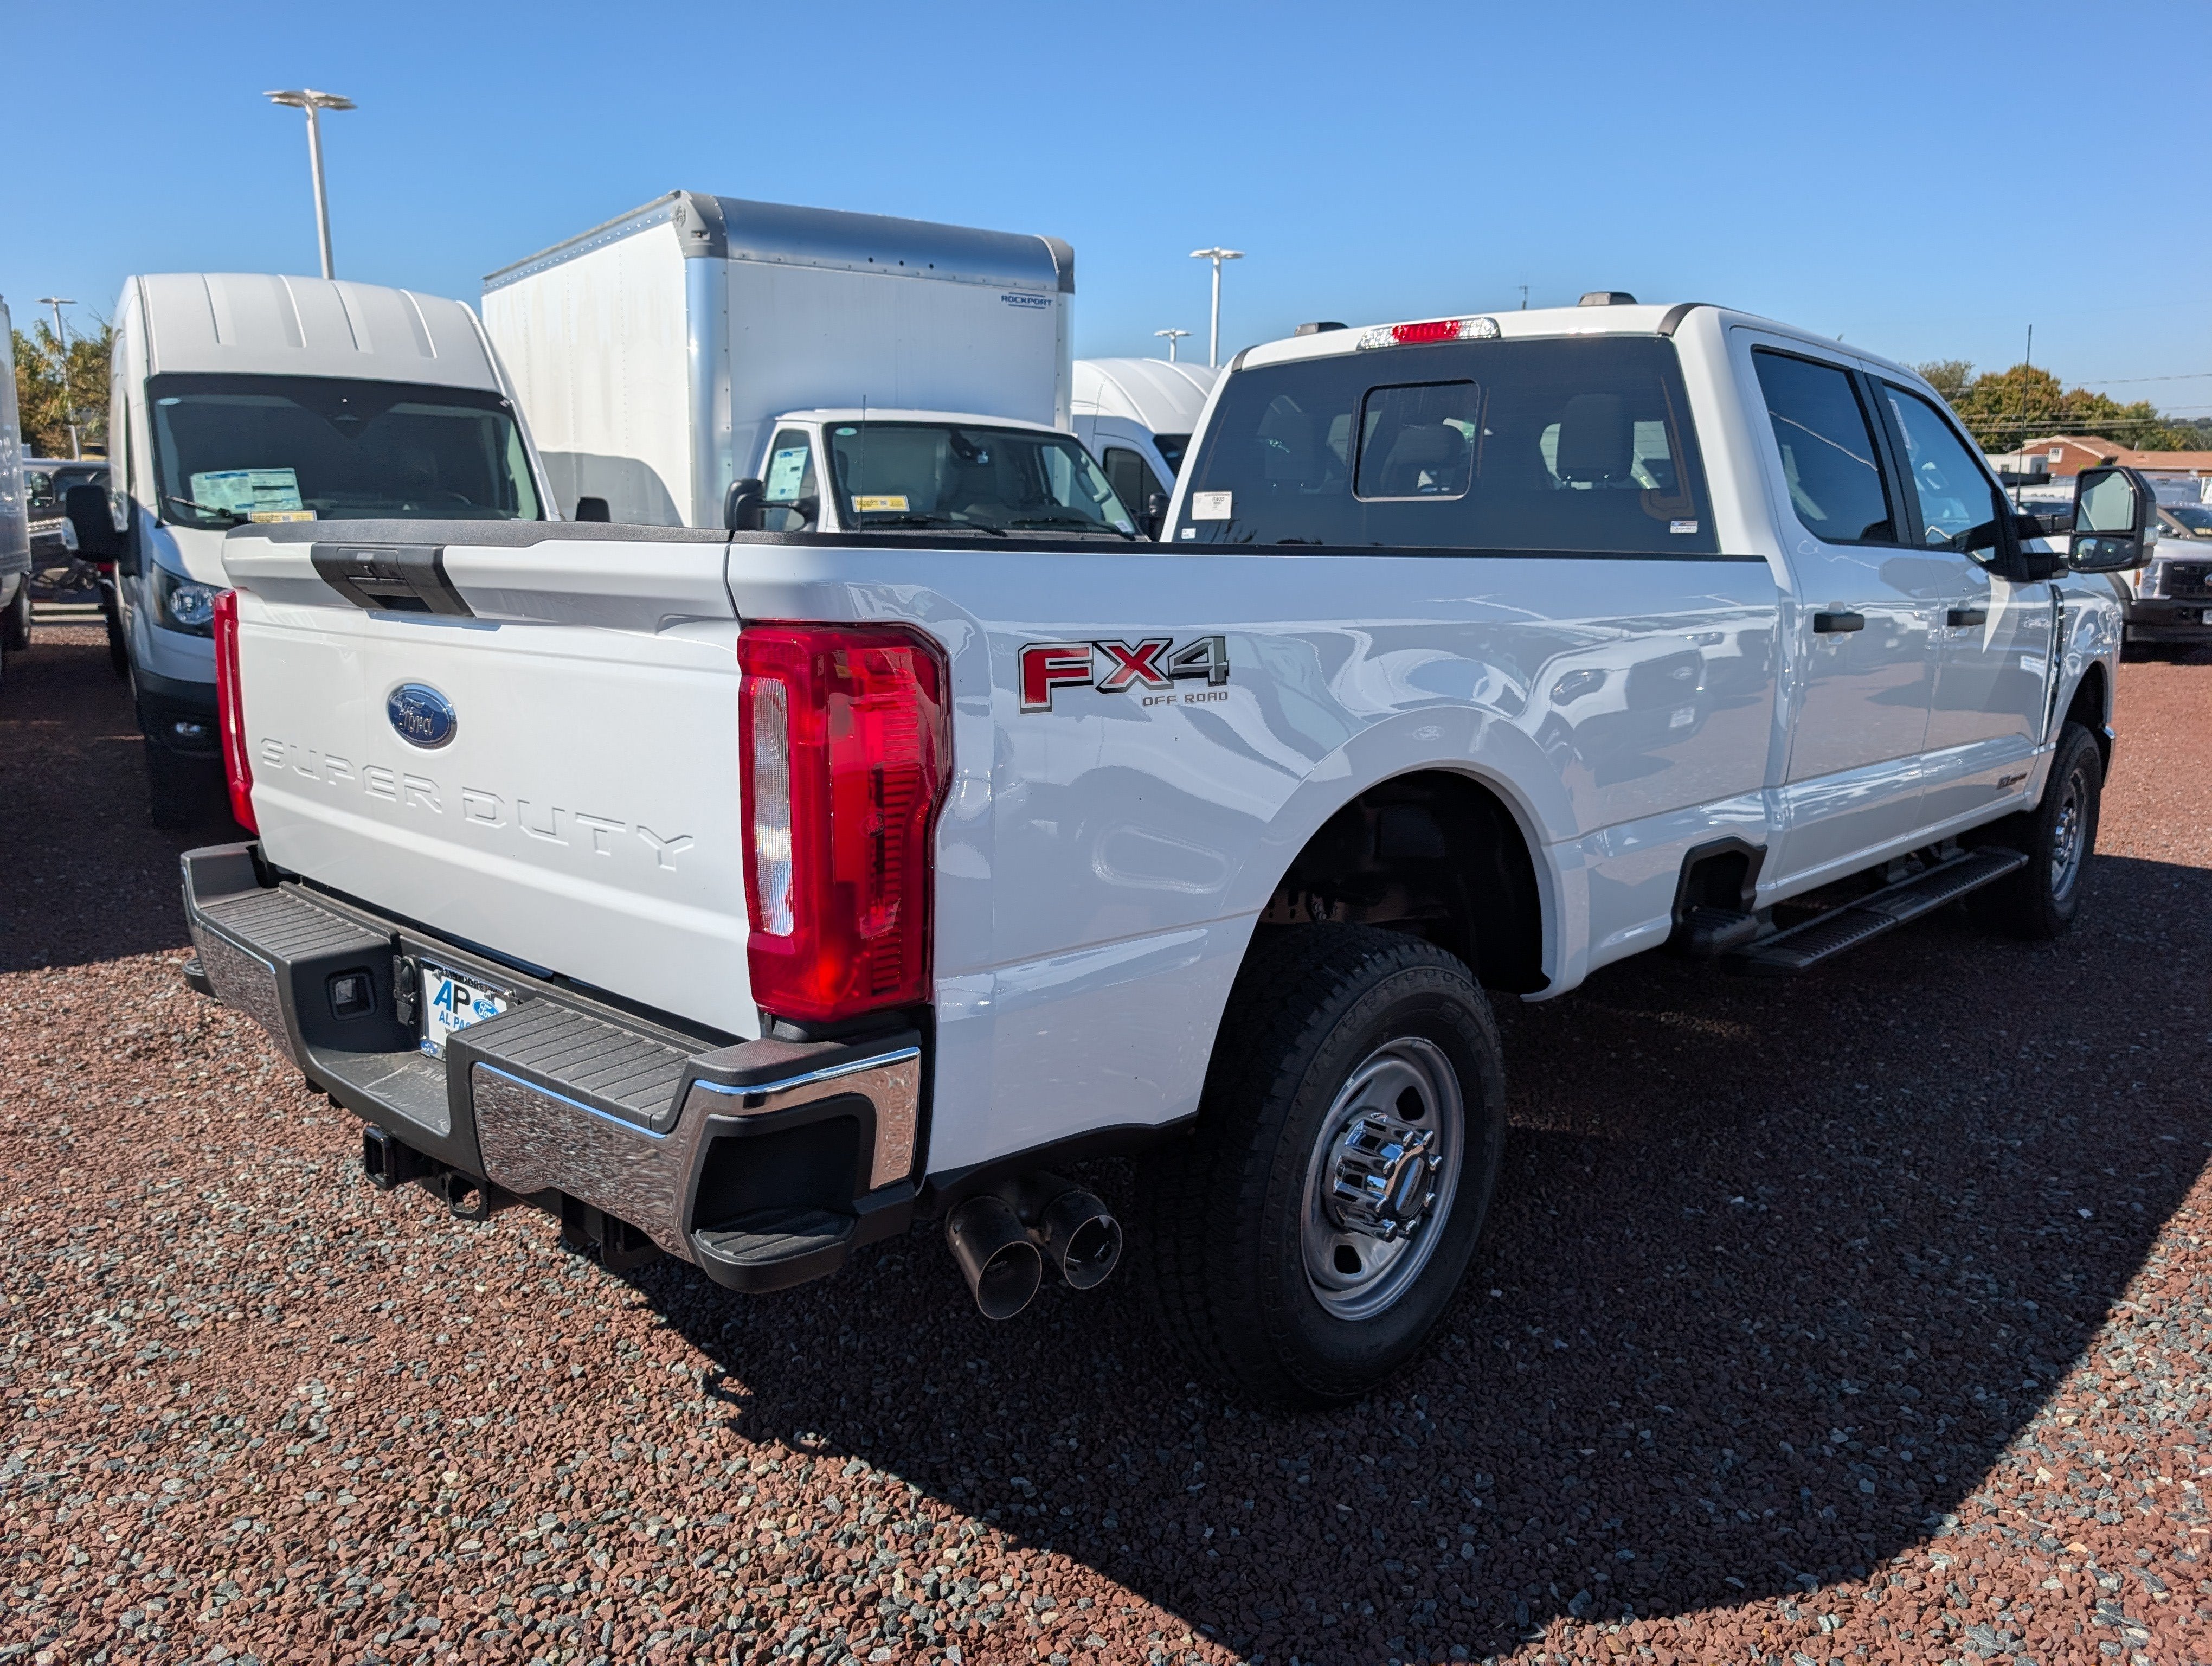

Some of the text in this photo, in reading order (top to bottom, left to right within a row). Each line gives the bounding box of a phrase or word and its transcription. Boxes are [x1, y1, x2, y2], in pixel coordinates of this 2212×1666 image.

[1000, 295, 1052, 306] ROCKPORT
[1017, 635, 1230, 714] FX4
[398, 697, 435, 736] Ford
[1142, 692, 1228, 706] OFF ROAD
[260, 736, 695, 872] SUPER DUTY
[433, 979, 471, 1015] AP
[439, 1010, 451, 1026] AL
